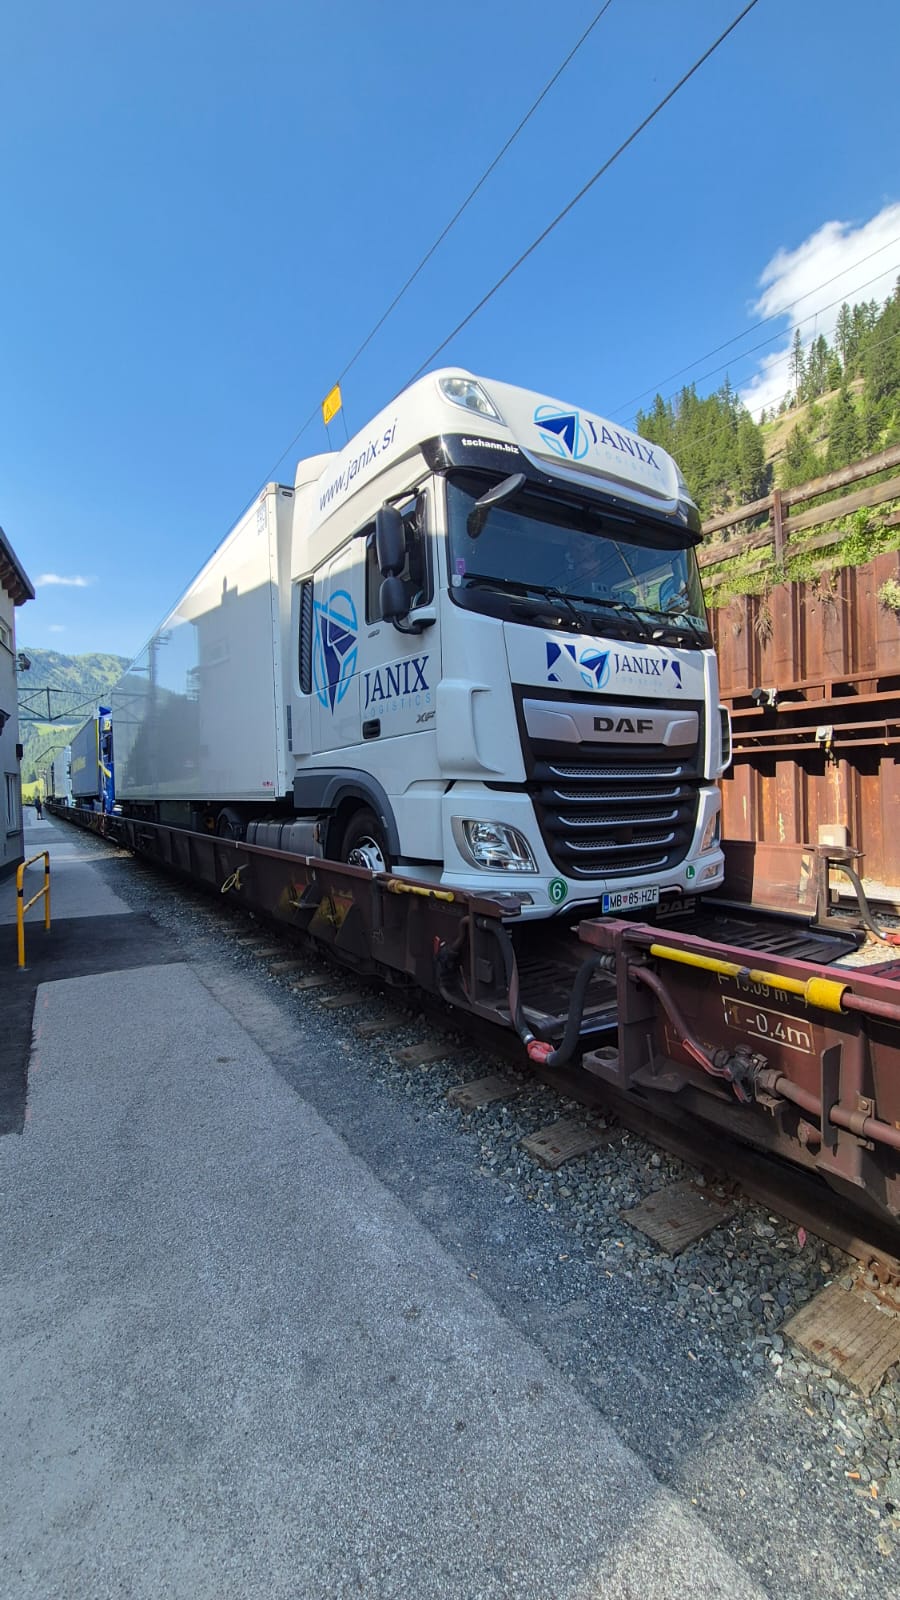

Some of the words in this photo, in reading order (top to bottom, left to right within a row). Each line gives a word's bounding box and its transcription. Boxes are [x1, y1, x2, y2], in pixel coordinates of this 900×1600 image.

[461, 438, 519, 454] tschann.biz
[585, 419, 661, 471] JANIX
[318, 418, 398, 511] www.janix.si
[614, 653, 661, 676] JANIX
[363, 655, 430, 711] JANIX
[363, 692, 432, 719] LOGISTICS
[594, 716, 654, 734] DAF
[552, 882, 562, 900] 6
[610, 894, 622, 908] MB
[656, 897, 696, 914] DAF
